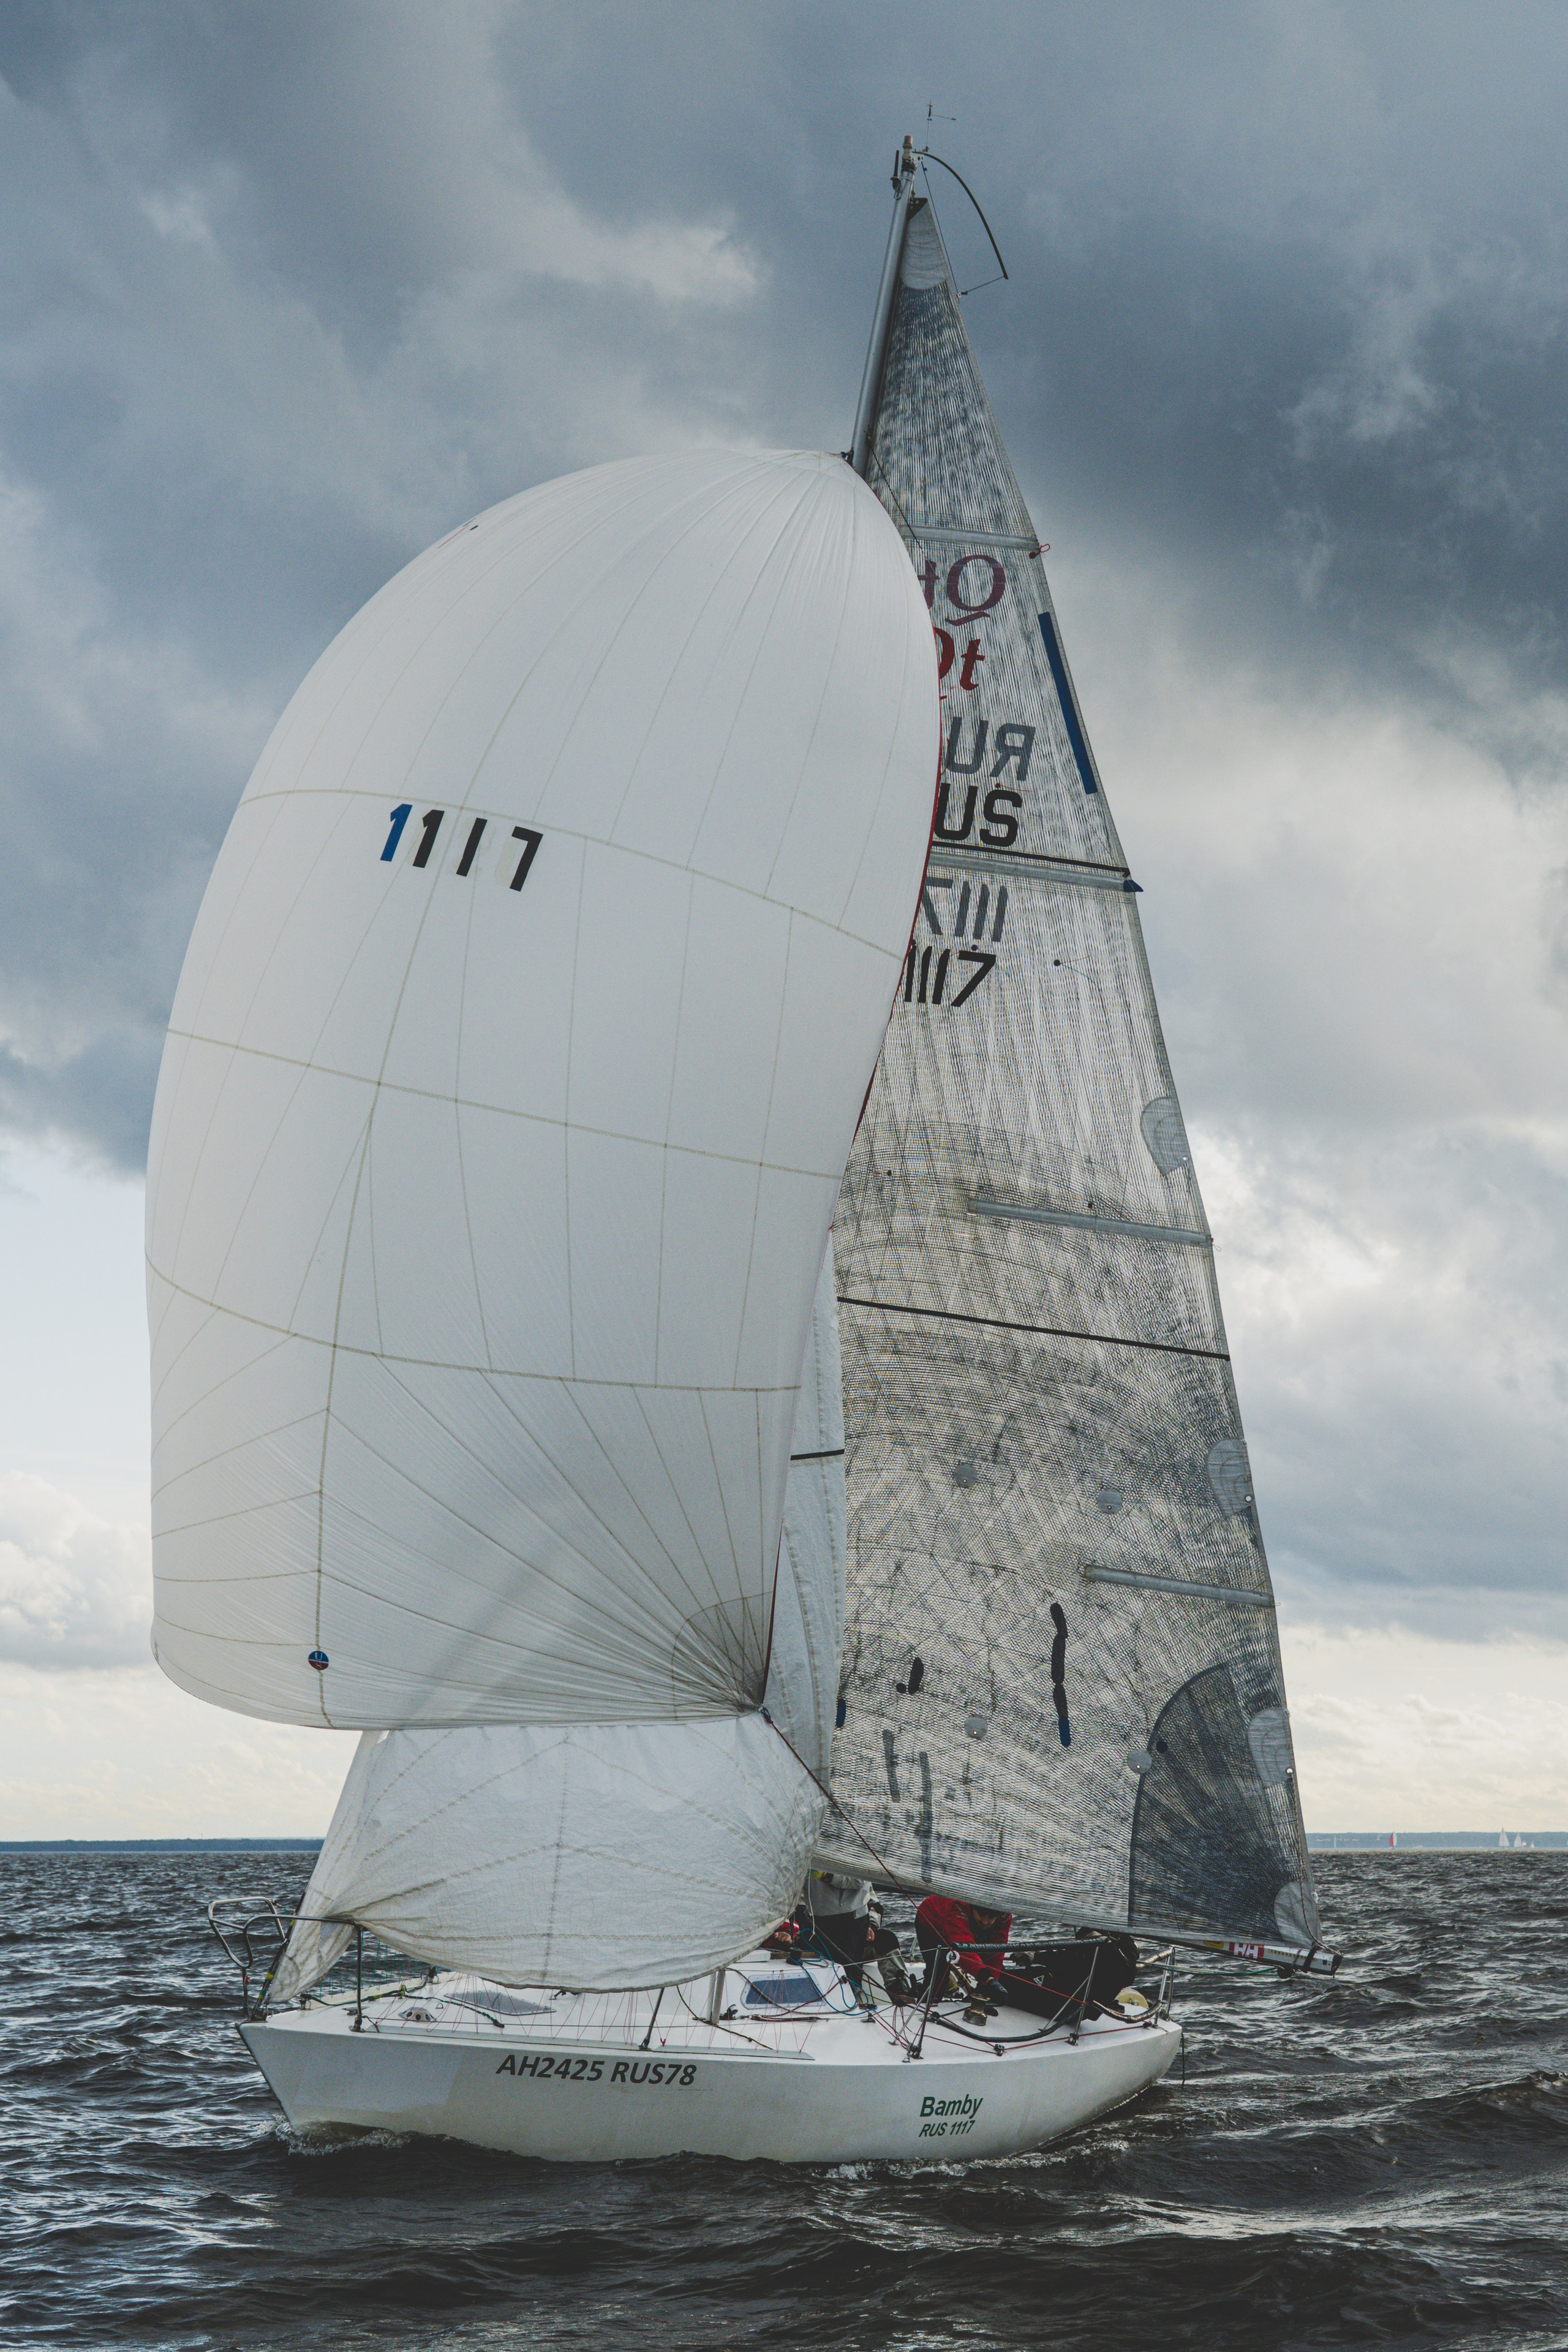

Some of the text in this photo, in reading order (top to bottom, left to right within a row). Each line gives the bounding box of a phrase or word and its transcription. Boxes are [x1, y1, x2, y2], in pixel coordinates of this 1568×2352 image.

[380, 803, 543, 892] 1117
[904, 946, 996, 1007] 1117
[496, 2054, 697, 2086] AH2425 RUS78
[919, 2094, 984, 2119] Bamby
[919, 2120, 976, 2138] RUS 1117
